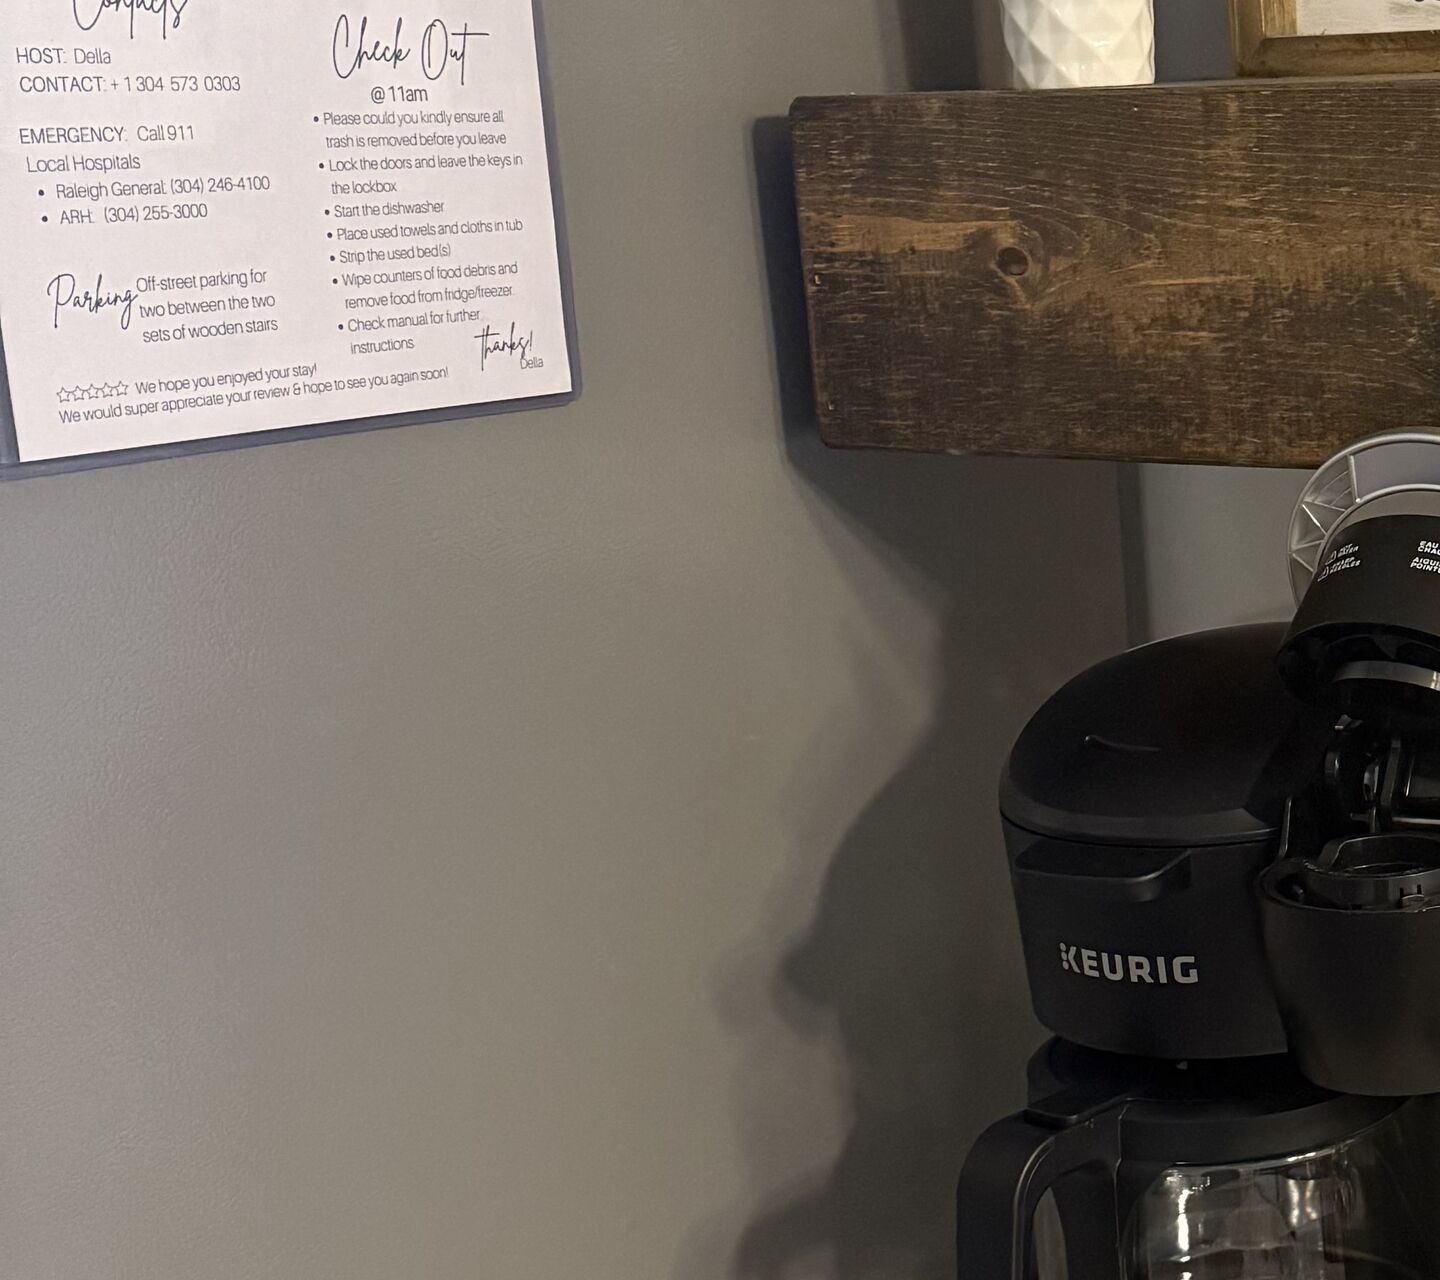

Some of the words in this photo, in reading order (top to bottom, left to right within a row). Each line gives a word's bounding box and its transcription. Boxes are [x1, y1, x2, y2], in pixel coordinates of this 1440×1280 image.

[16, 47, 67, 64] HOST:
[74, 48, 111, 64] Della
[332, 14, 411, 78] Check
[421, 18, 490, 86] Out
[19, 76, 107, 93] CONTACT:
[136, 76, 164, 91] 304
[170, 76, 198, 91] 573
[204, 76, 241, 91] 0303
[370, 86, 385, 104] @
[388, 86, 428, 102] 11am
[323, 112, 361, 125] Please
[363, 111, 396, 125] could
[396, 114, 418, 127] you
[420, 111, 452, 126] kindly
[454, 111, 491, 123] ensure
[492, 110, 504, 122] all
[19, 126, 127, 144] EMERGENCY:
[137, 125, 165, 141] Call
[167, 124, 194, 140] 911
[326, 134, 354, 148] trash
[356, 135, 366, 147] is
[367, 133, 417, 147] removed
[419, 133, 454, 146] before
[456, 134, 477, 148] you
[478, 132, 507, 145] leave
[26, 155, 69, 172] Local
[72, 153, 141, 174] Hospitals
[329, 157, 358, 172] Lock
[359, 157, 378, 170] the
[380, 156, 413, 169] doors
[414, 155, 436, 169] and
[437, 155, 467, 168] leave
[468, 154, 486, 167] the
[487, 153, 512, 169] keys
[513, 154, 523, 166] in
[56, 182, 108, 201] Raleigh
[170, 177, 204, 195] (304)
[207, 175, 270, 193] 246-4100
[331, 181, 350, 195] the
[352, 179, 397, 194] lockbox
[104, 206, 139, 223] (304)
[143, 203, 208, 221] 255-3000
[334, 204, 360, 218] Start
[362, 202, 381, 216] the
[382, 200, 444, 216] dishwasher
[337, 227, 369, 241] Place
[370, 224, 399, 239] used
[399, 223, 436, 237] towels
[438, 221, 459, 236] and
[461, 220, 493, 233] cloths
[494, 220, 505, 232] in
[506, 219, 523, 232] tub
[339, 249, 365, 265] Strip
[367, 248, 386, 262] the
[387, 245, 415, 260] used
[417, 243, 451, 258] bed(s)
[136, 275, 197, 293] Off-street
[200, 271, 248, 290] parking
[250, 268, 267, 283] for
[342, 272, 372, 288] Wipe
[373, 269, 423, 285] counters
[424, 266, 435, 281] of
[437, 265, 462, 279] food
[464, 262, 496, 278] debris
[498, 261, 518, 275] and
[47, 273, 138, 330] Parking
[139, 302, 166, 318] two
[168, 297, 226, 316] between
[228, 295, 249, 311] the
[251, 292, 276, 308] two
[345, 294, 388, 309] remove
[390, 290, 416, 305] food
[418, 288, 443, 303] from
[142, 327, 171, 343] sets
[173, 324, 187, 340] of
[188, 321, 244, 339] wooden
[246, 318, 278, 334] stairs
[348, 316, 385, 332] Check
[387, 313, 429, 329] manual
[429, 312, 444, 326] for
[446, 308, 481, 324] further
[350, 338, 415, 355] instructions
[474, 321, 533, 371] thanks!
[520, 356, 544, 370] Della
[135, 379, 157, 395] We
[158, 377, 190, 396] hope
[192, 375, 215, 390] you
[217, 368, 263, 389] enjoyed
[265, 365, 290, 384] your
[293, 363, 317, 379] stay!
[58, 407, 81, 423] We
[82, 403, 122, 421] would
[124, 401, 159, 418] super
[161, 394, 224, 413] appreciate
[225, 390, 251, 406] your
[253, 385, 291, 401] review
[303, 381, 332, 397] hope
[334, 378, 345, 391] to
[347, 376, 367, 389] see
[369, 375, 389, 391] you
[390, 371, 419, 387] again
[420, 366, 449, 381] soon!
[1059, 942, 1199, 984] KEURIG
